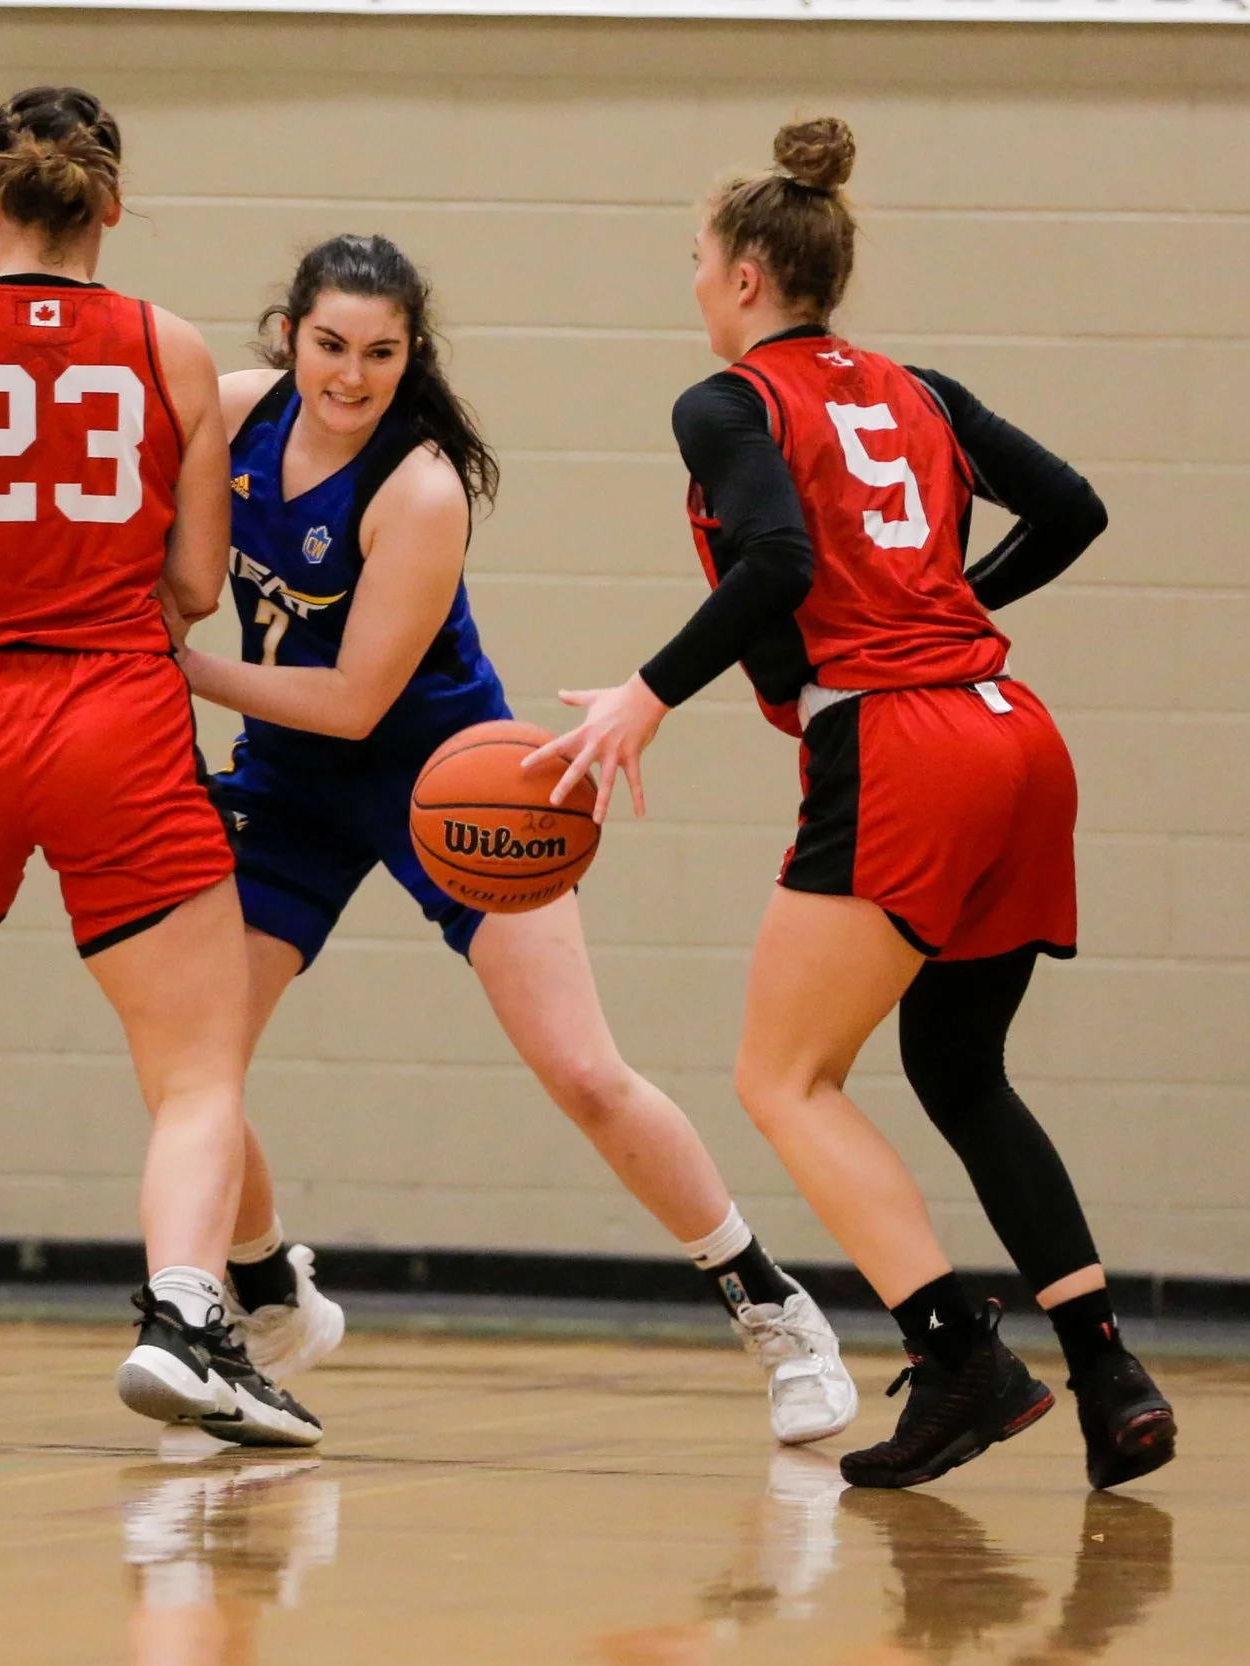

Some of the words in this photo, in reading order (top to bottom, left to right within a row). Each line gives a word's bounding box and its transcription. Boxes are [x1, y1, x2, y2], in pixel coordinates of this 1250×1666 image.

[824, 400, 931, 550] 5
[253, 598, 290, 667] 7
[443, 820, 567, 860] Wilson
